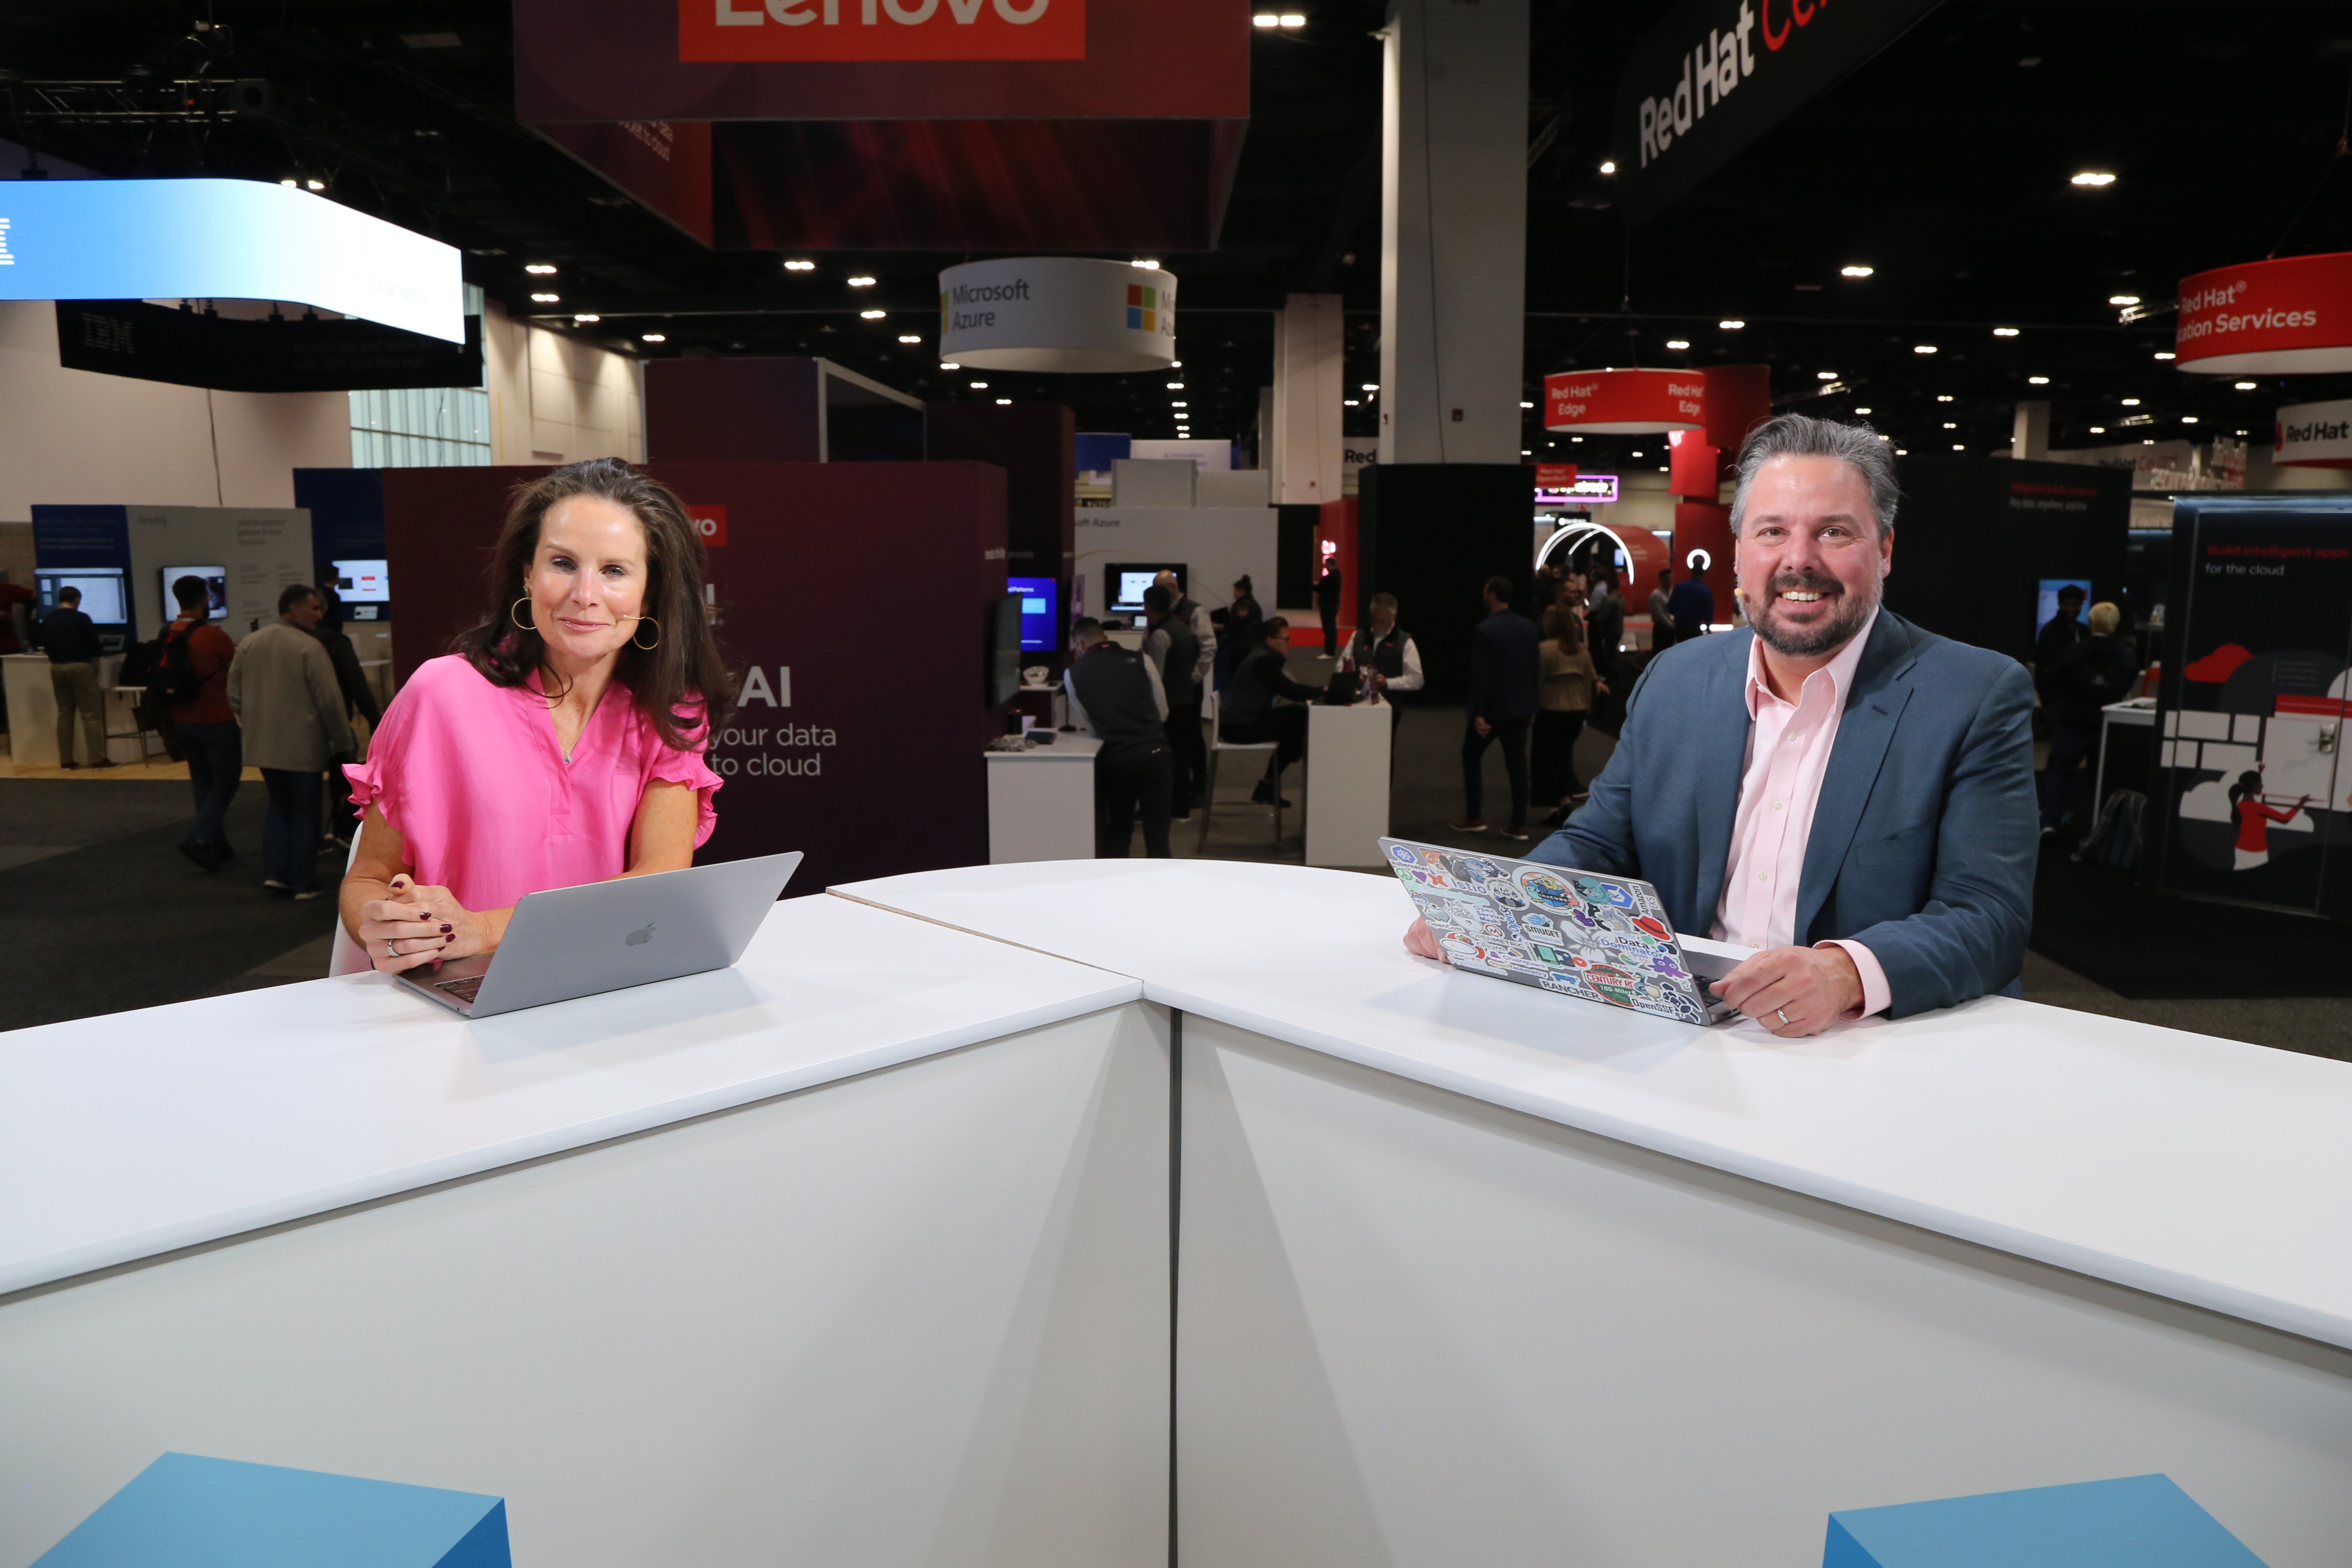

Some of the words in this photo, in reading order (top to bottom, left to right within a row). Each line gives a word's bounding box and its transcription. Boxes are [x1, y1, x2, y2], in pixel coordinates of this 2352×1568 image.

[1640, 52, 1693, 169] Red
[1695, 0, 1755, 120] Hat
[1761, 0, 1829, 52] Ce
[952, 279, 1030, 306] Microsoft
[2180, 289, 2202, 315] Red
[952, 309, 995, 331] Azure
[2215, 308, 2317, 334] Services
[83, 313, 135, 354] IBM
[1551, 386, 1569, 400] Red
[1668, 383, 1690, 397] Red
[1558, 403, 1586, 417] Edge
[2286, 422, 2312, 444] Red
[2314, 421, 2349, 441] Hat
[1344, 448, 1377, 463] Red
[1092, 518, 1120, 527] Azure
[2207, 544, 2241, 556] Build
[2243, 545, 2312, 559] intelligent
[2315, 547, 2350, 560] apps
[2205, 563, 2223, 574] for
[2226, 563, 2246, 575] the
[2249, 564, 2285, 576] cloud
[737, 666, 792, 707] AI
[710, 727, 769, 750] your
[775, 722, 836, 746] data
[711, 753, 739, 775] to
[746, 752, 821, 776] cloud
[1391, 860, 1429, 871] kubernetes
[1451, 878, 1487, 894] Istio
[1632, 885, 1651, 915] Amazon
[1646, 897, 1658, 909] EKS
[1473, 905, 1496, 914] Open
[1477, 910, 1504, 920] Service
[1427, 920, 1464, 932] OpenCost
[1525, 925, 1560, 938] SMUGET
[1476, 940, 1506, 952] cilium
[1600, 938, 1663, 959] Dominator
[1618, 936, 1650, 949] Data
[1489, 960, 1547, 978] OpenTelemetry
[1502, 954, 1546, 969] Chainguard
[1586, 974, 1622, 986] CENTURY
[1542, 980, 1601, 1000] RANCHER
[1632, 998, 1675, 1014] OpenSSF
